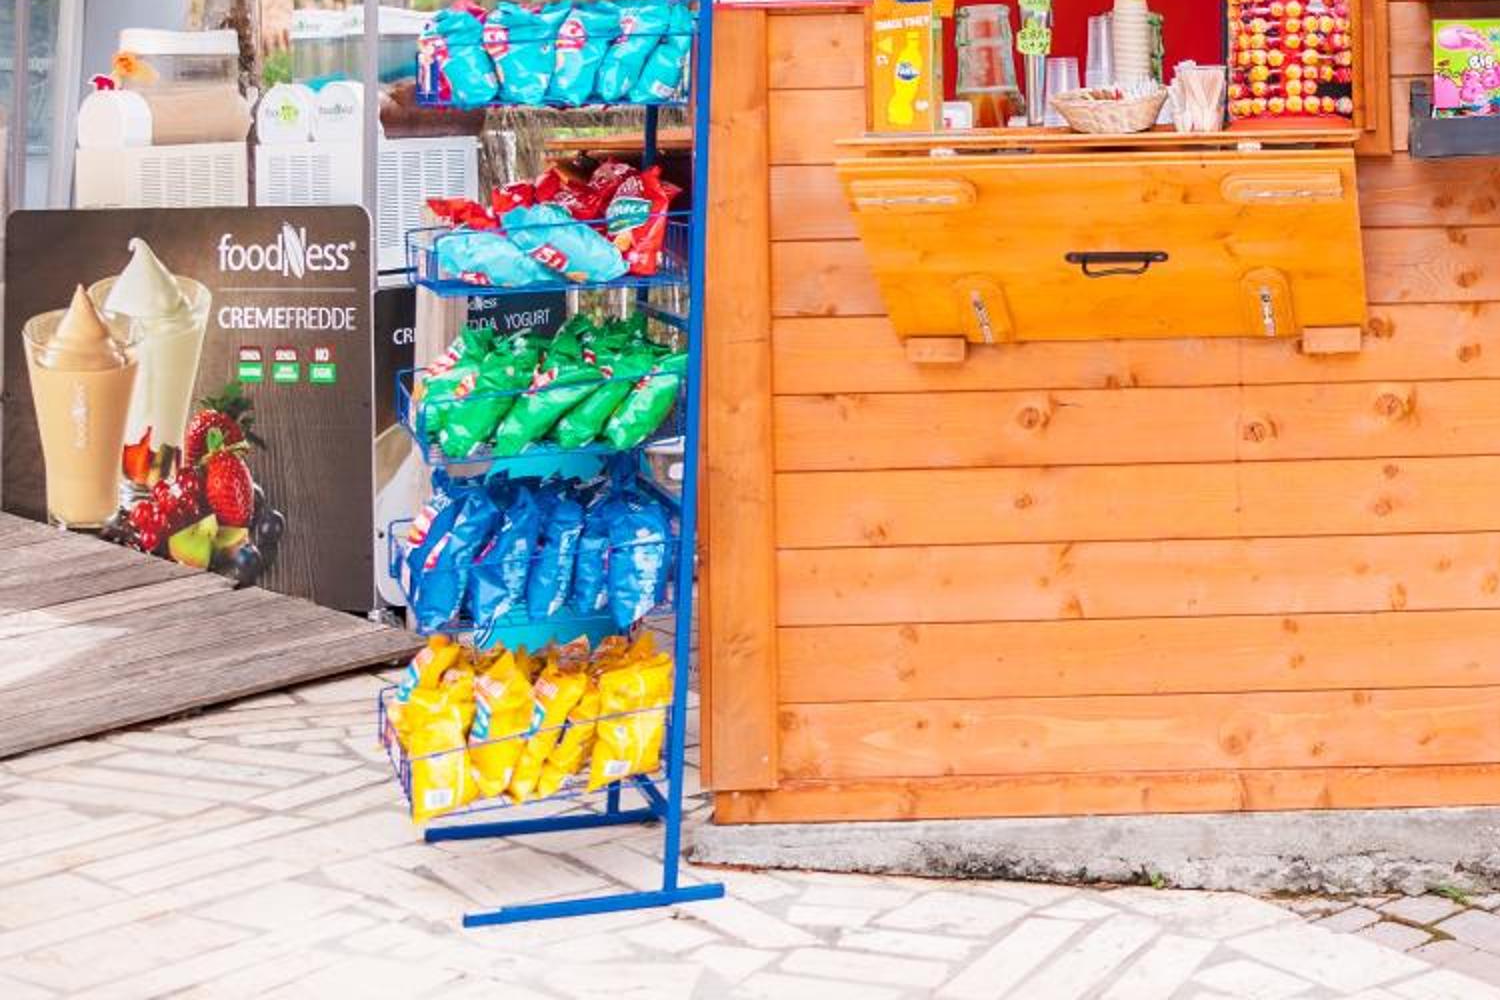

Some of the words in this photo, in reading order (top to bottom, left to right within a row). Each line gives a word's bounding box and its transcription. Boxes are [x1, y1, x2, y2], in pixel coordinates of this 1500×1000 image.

[217, 306, 357, 331] CREMEFREDDE
[504, 308, 550, 330] YOGURT
[393, 328, 416, 345] CR
